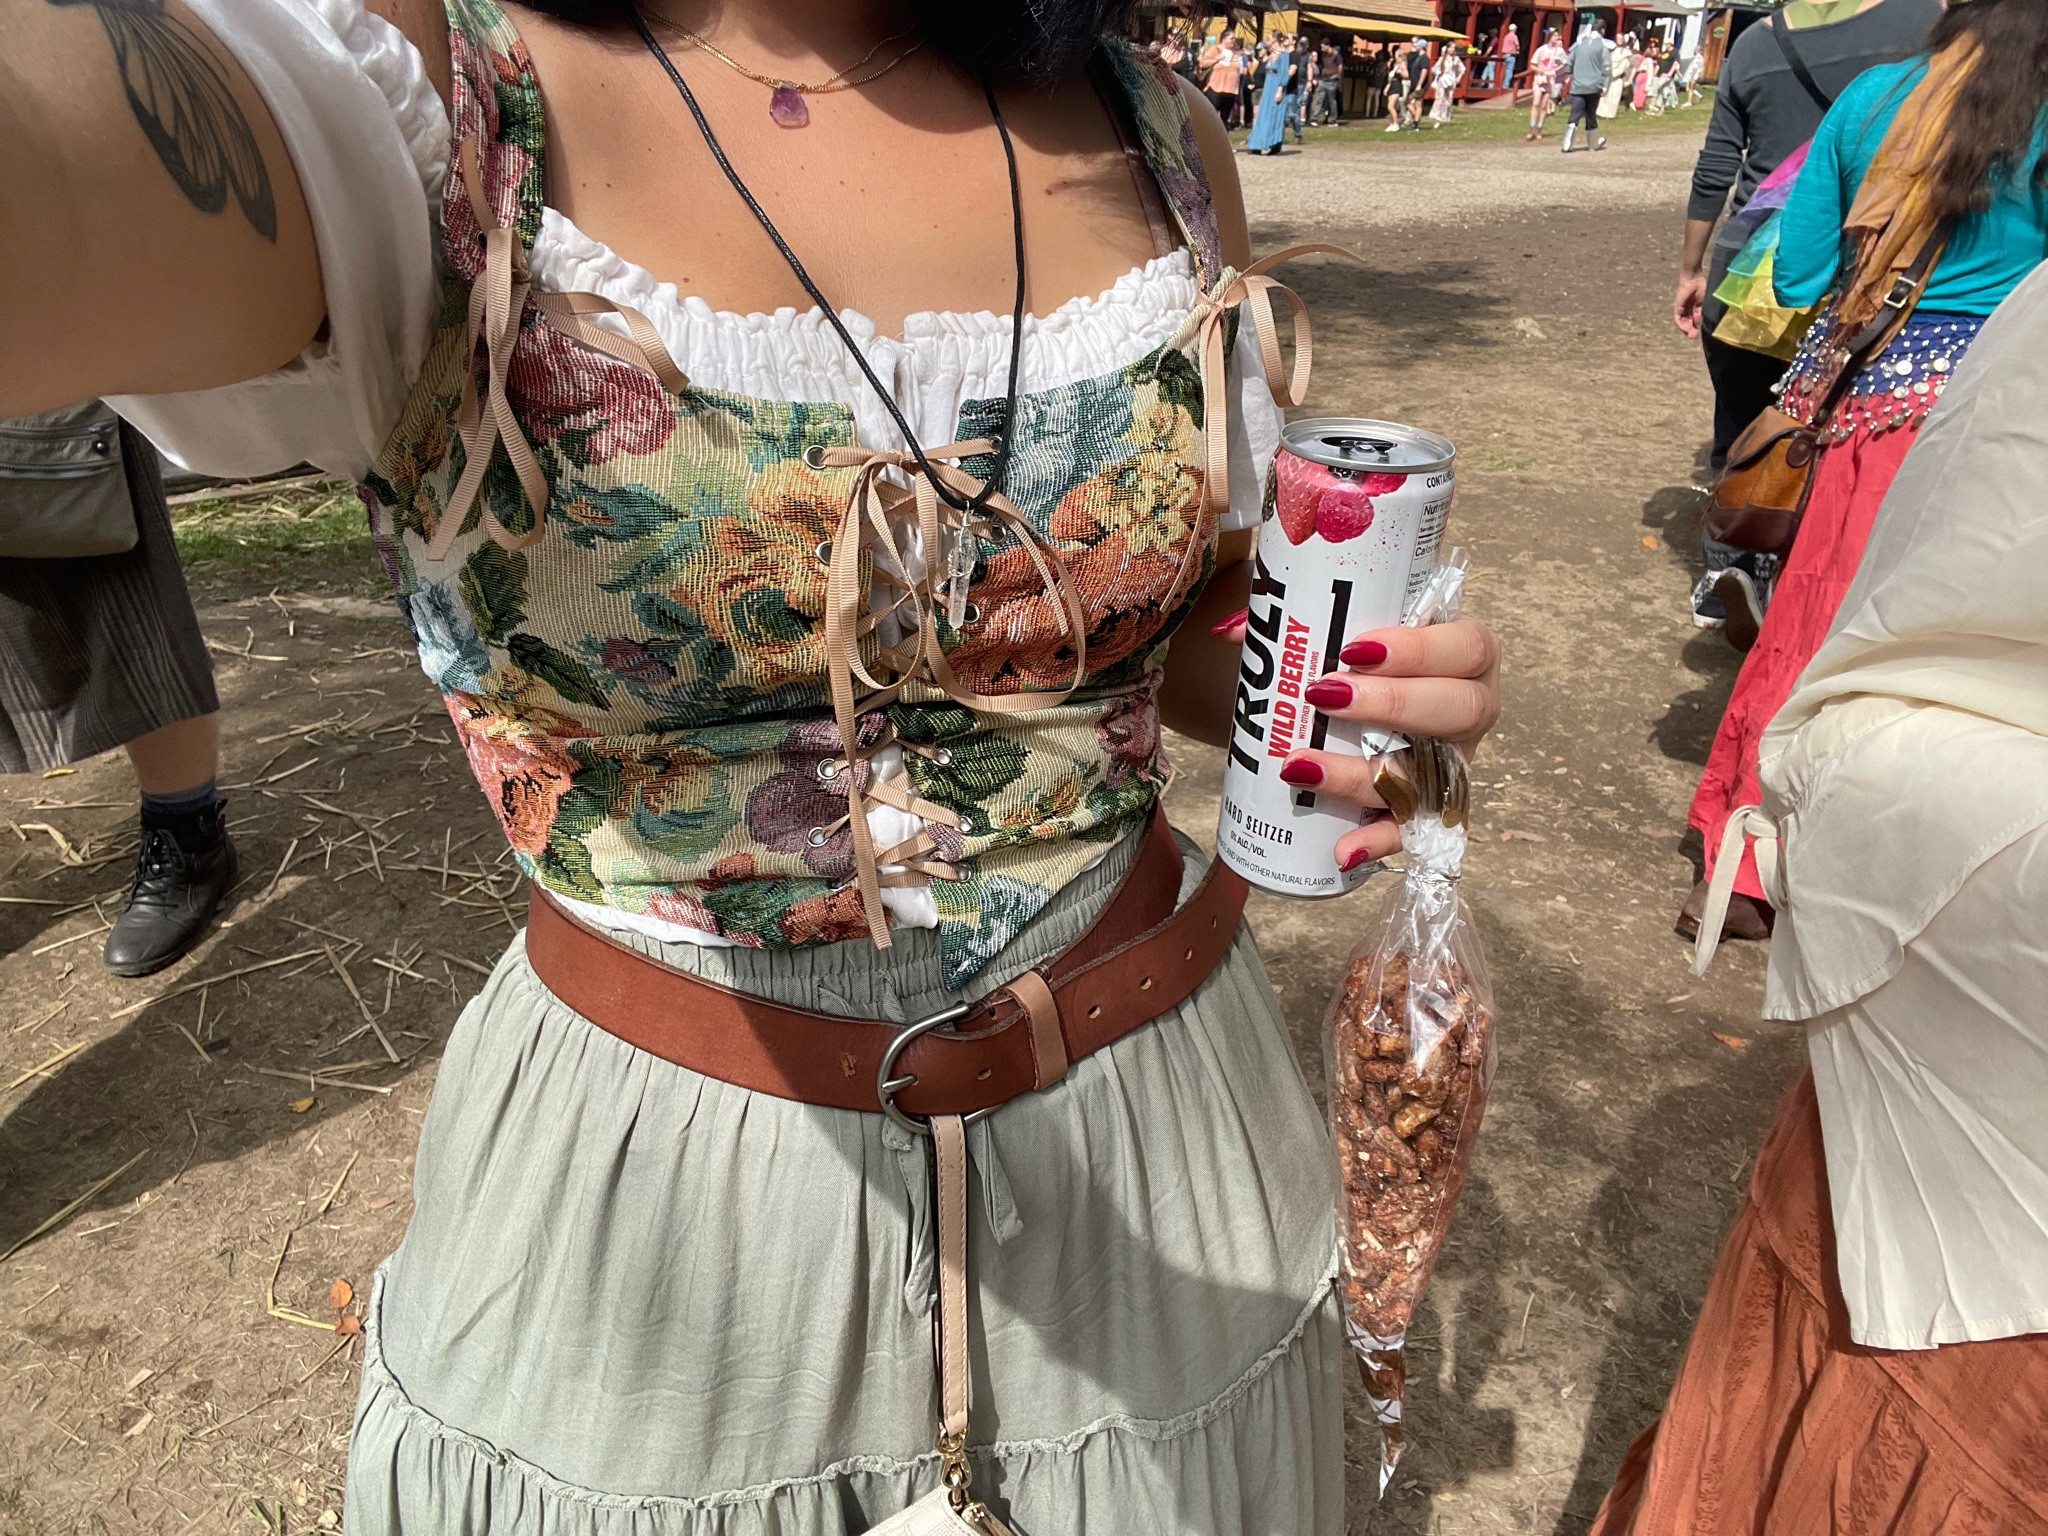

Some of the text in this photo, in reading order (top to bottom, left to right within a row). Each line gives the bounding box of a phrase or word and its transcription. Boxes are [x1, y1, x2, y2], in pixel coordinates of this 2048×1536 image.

[1228, 547, 1287, 776] TRULY
[1308, 651, 1320, 679] FLAVORS
[1267, 614, 1311, 758] WILD BERRY
[1301, 705, 1311, 723] OTHER
[1298, 723, 1308, 740] WITH
[1224, 795, 1243, 824] HARD
[1245, 815, 1293, 846] SELTZER
[1235, 854, 1250, 869] WITH
[1249, 861, 1271, 878] OTHER
[1271, 871, 1303, 886] NATURAL
[1304, 877, 1336, 886] FLAVORS
